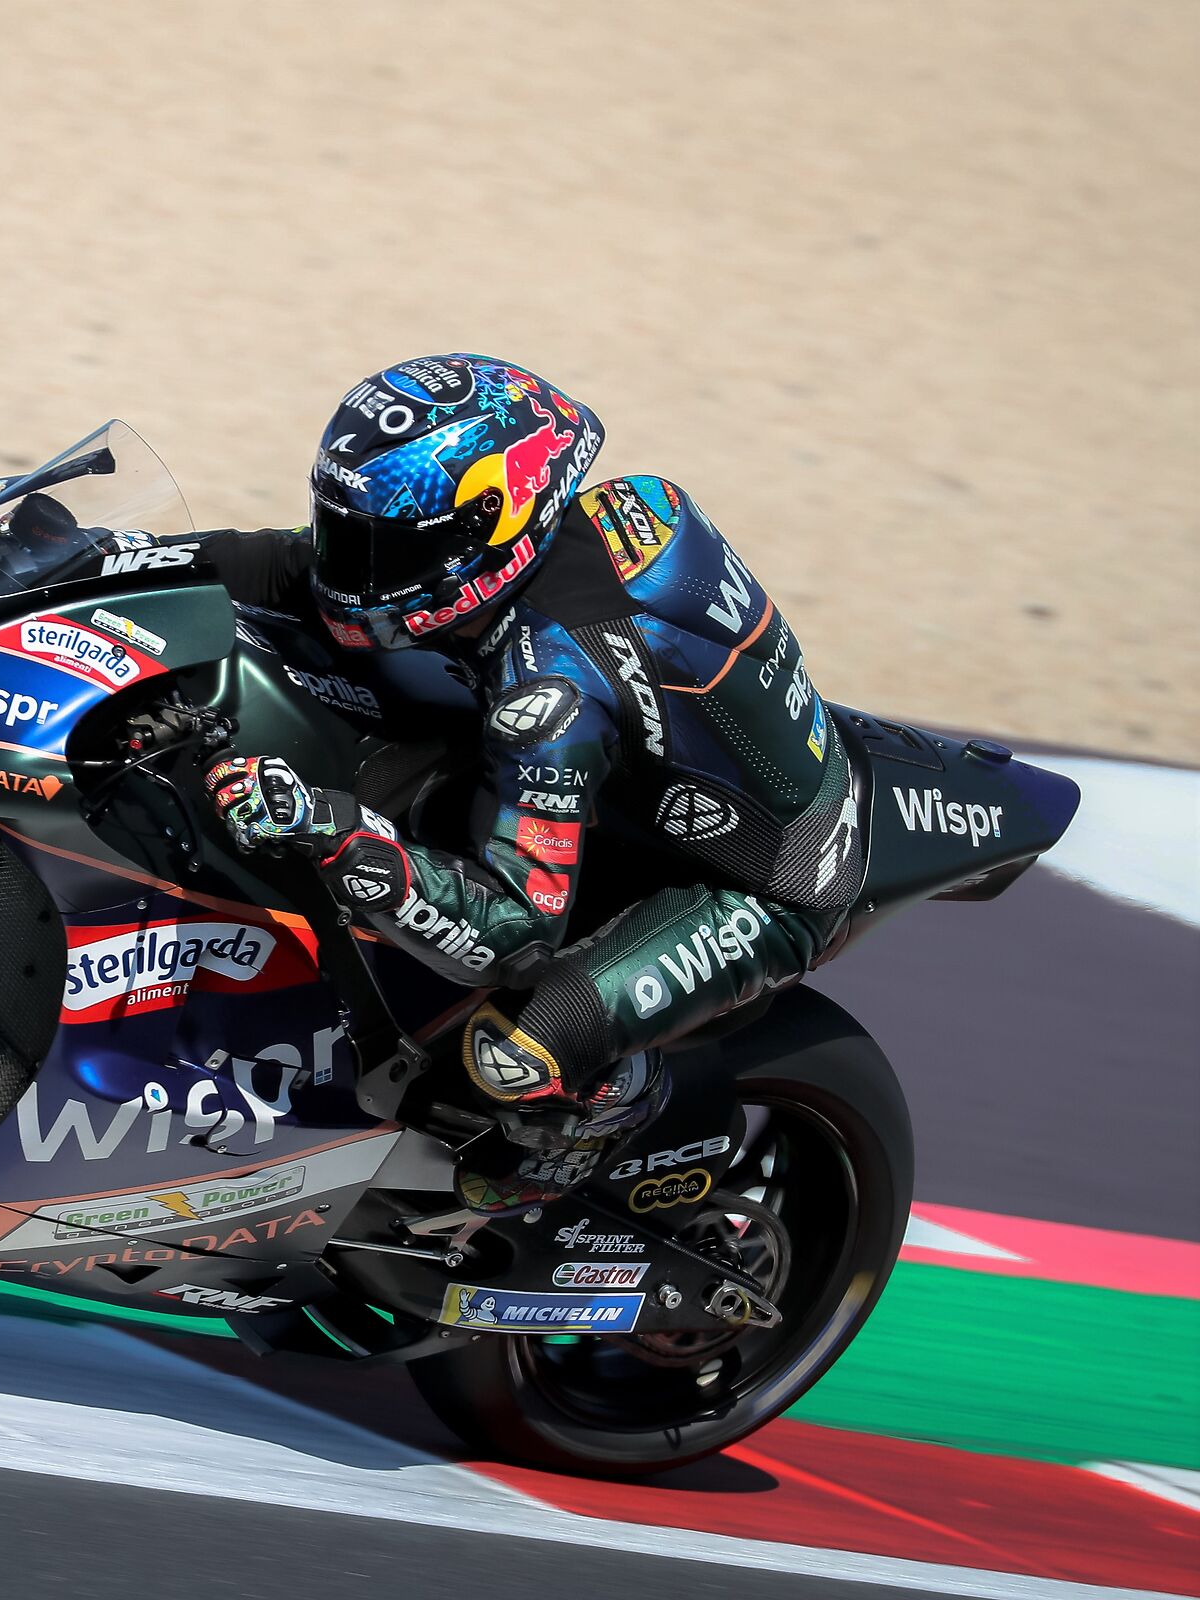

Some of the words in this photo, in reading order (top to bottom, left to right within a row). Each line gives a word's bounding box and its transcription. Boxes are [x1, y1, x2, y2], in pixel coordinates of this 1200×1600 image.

[318, 448, 372, 493] SHARK
[539, 417, 598, 528] SHARK
[416, 511, 456, 529] SHARK
[100, 543, 201, 577] WRS
[390, 583, 422, 598] HYUNDAI
[401, 582, 482, 637] Red
[472, 533, 536, 601] Bull
[27, 625, 131, 679] sterilgarda
[53, 655, 93, 674] alimenti
[283, 665, 380, 709] aprilia
[319, 695, 383, 719] RACING
[519, 789, 581, 811] RNF
[892, 786, 1003, 847] Wispr
[533, 834, 573, 848] Cofidis
[657, 895, 772, 995] Wispr
[66, 927, 262, 996] sterilgarda
[16, 1026, 348, 1162] Wispr
[646, 1135, 731, 1172] RCB
[65, 1207, 151, 1230] Green
[201, 1175, 293, 1208] Power
[641, 1180, 699, 1199] REGINA
[575, 1234, 635, 1244] SPRINT
[588, 1243, 646, 1254] FILTER
[573, 1265, 642, 1285] Castrol
[158, 1283, 294, 1310] RNF
[501, 1305, 624, 1322] MICHELIN
